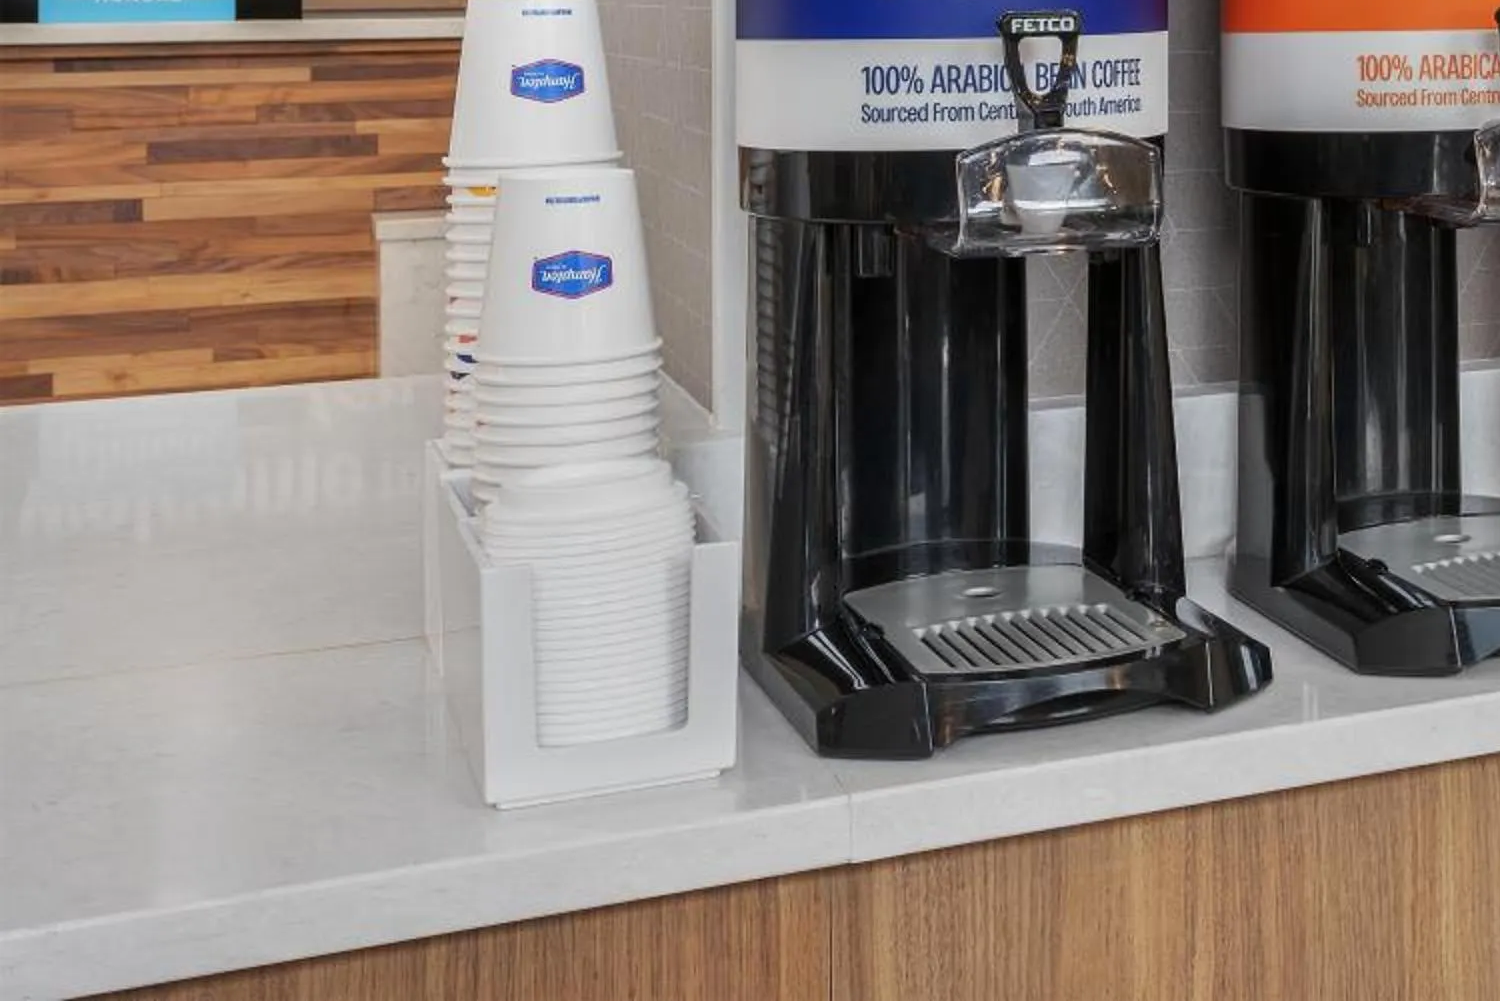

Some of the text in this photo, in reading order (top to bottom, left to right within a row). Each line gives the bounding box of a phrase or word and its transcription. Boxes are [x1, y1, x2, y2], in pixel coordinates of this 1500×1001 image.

[1011, 16, 1075, 33] FETCO
[860, 65, 924, 95] 100%
[930, 63, 1016, 94] ARABIC
[1092, 58, 1141, 90] COFFEE
[1357, 54, 1412, 81] 100%
[861, 94, 1141, 123] Sourced From Cent outh America
[1356, 88, 1417, 108] Sourced
[1422, 88, 1456, 106] From
